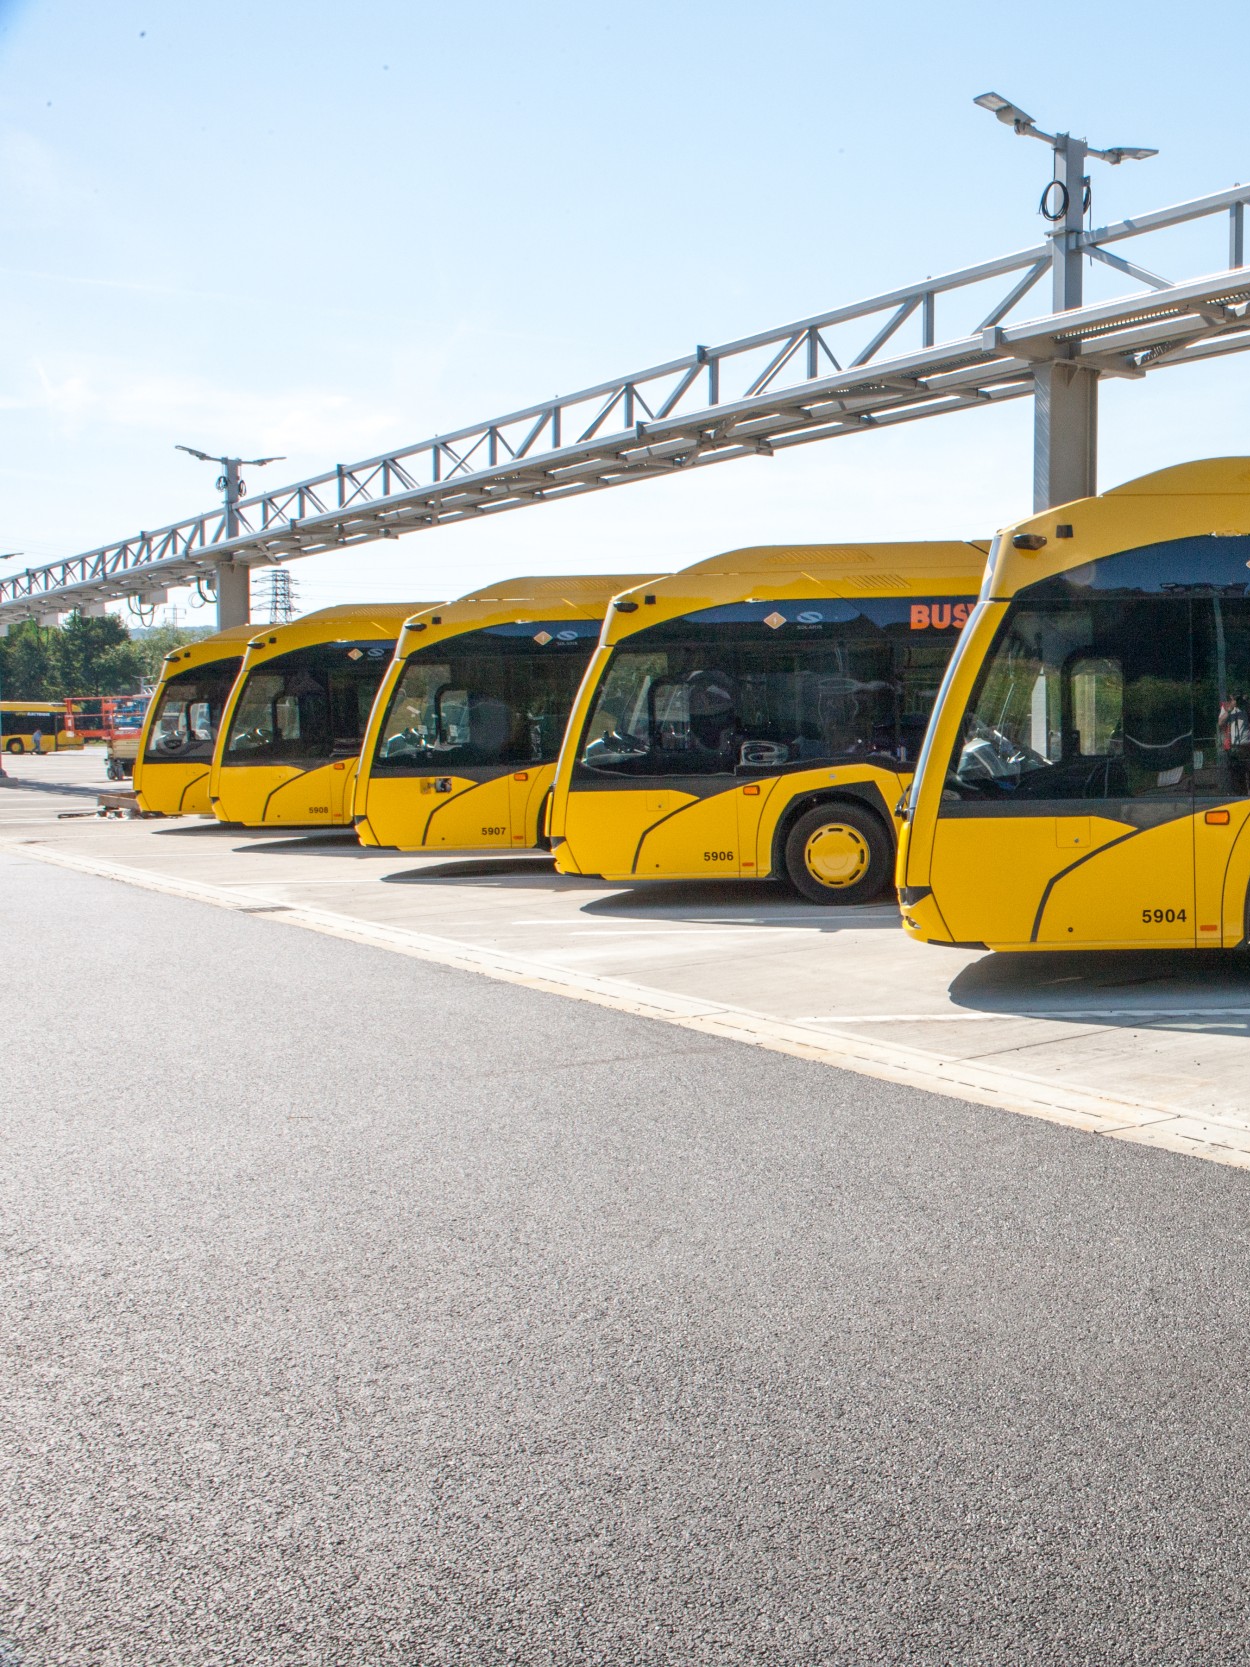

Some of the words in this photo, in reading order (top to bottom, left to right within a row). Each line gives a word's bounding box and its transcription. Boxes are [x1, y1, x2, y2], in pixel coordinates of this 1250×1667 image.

[481, 827, 507, 836] 5907
[703, 851, 734, 861] 5906
[1142, 908, 1187, 924] 5904
